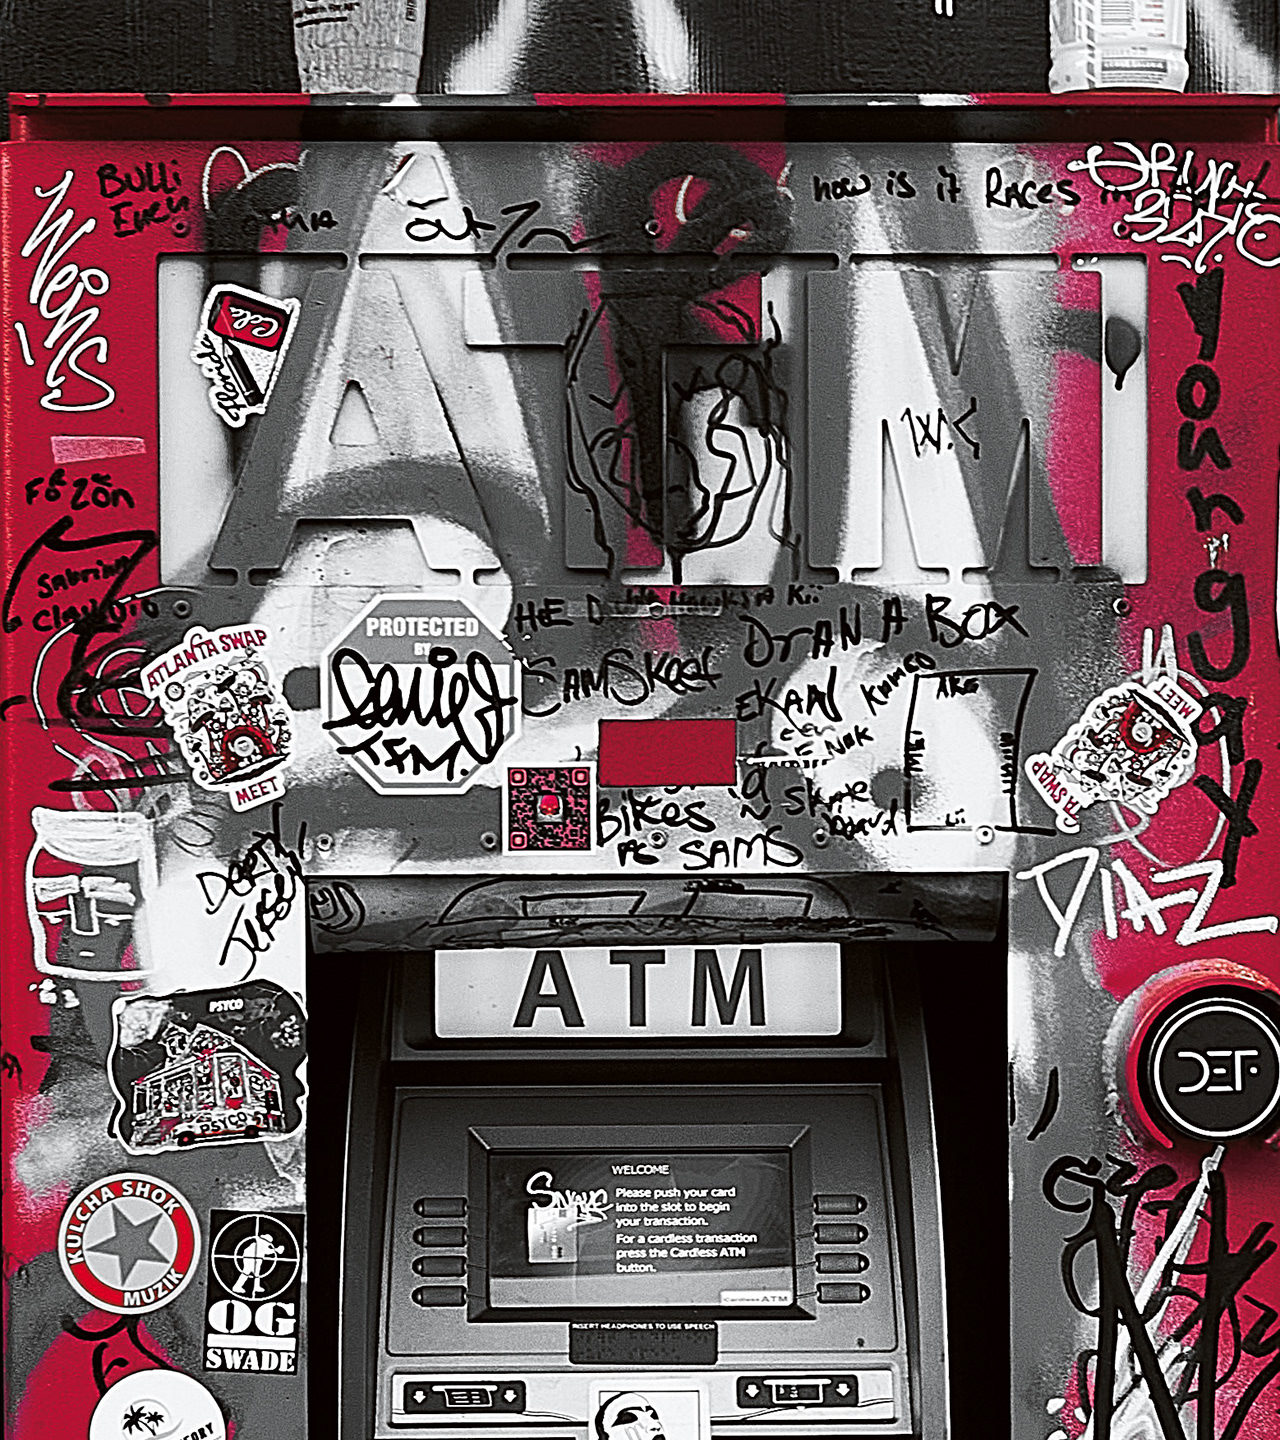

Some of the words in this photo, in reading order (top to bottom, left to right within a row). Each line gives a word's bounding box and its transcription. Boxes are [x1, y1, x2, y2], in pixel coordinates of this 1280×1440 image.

[218, 627, 269, 657] SWAP
[365, 616, 480, 638] PROTECTED
[235, 776, 280, 806] MEET
[512, 948, 767, 1028] ATM
[209, 998, 244, 1014] PSYCO
[611, 1164, 671, 1176] WELCOME
[615, 1187, 652, 1199] Please
[653, 1187, 681, 1200] push
[682, 1189, 709, 1200] your
[710, 1187, 736, 1199] card
[66, 1187, 116, 1265] KULCHA
[120, 1180, 181, 1216] SHOK
[122, 1267, 185, 1307] MUZIK
[207, 1298, 297, 1336] OG
[205, 1348, 296, 1373] SWADE
